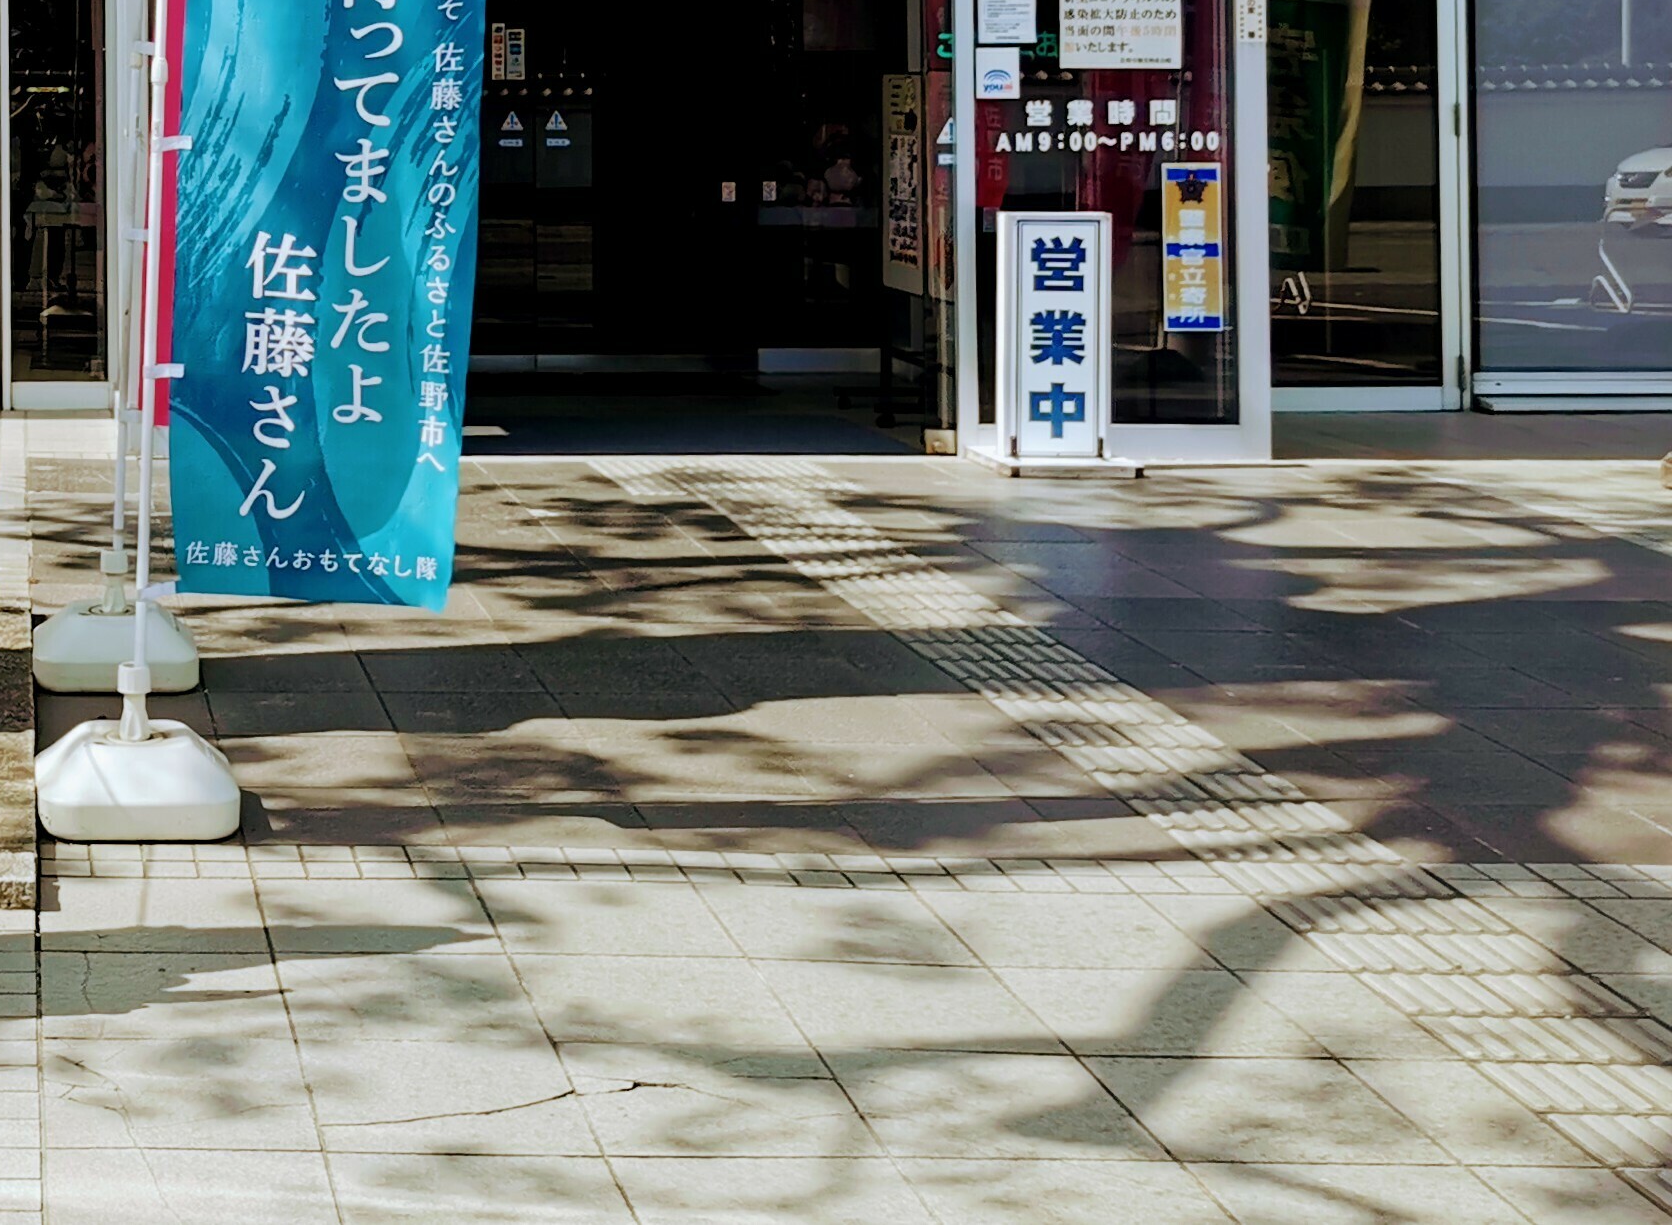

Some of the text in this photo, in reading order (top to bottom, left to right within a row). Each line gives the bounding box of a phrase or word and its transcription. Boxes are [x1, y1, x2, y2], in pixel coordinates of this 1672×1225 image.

[1064, 8, 1177, 20] 感染拡大防止のため
[1025, 99, 1177, 127] 営業時間
[416, 42, 466, 472] 佐藤さんのふるさと佐野市へ
[238, 230, 319, 520] 佐藤さん
[1029, 236, 1087, 439] 営業中
[185, 539, 438, 581] 佐藤さんおもてなし隊
